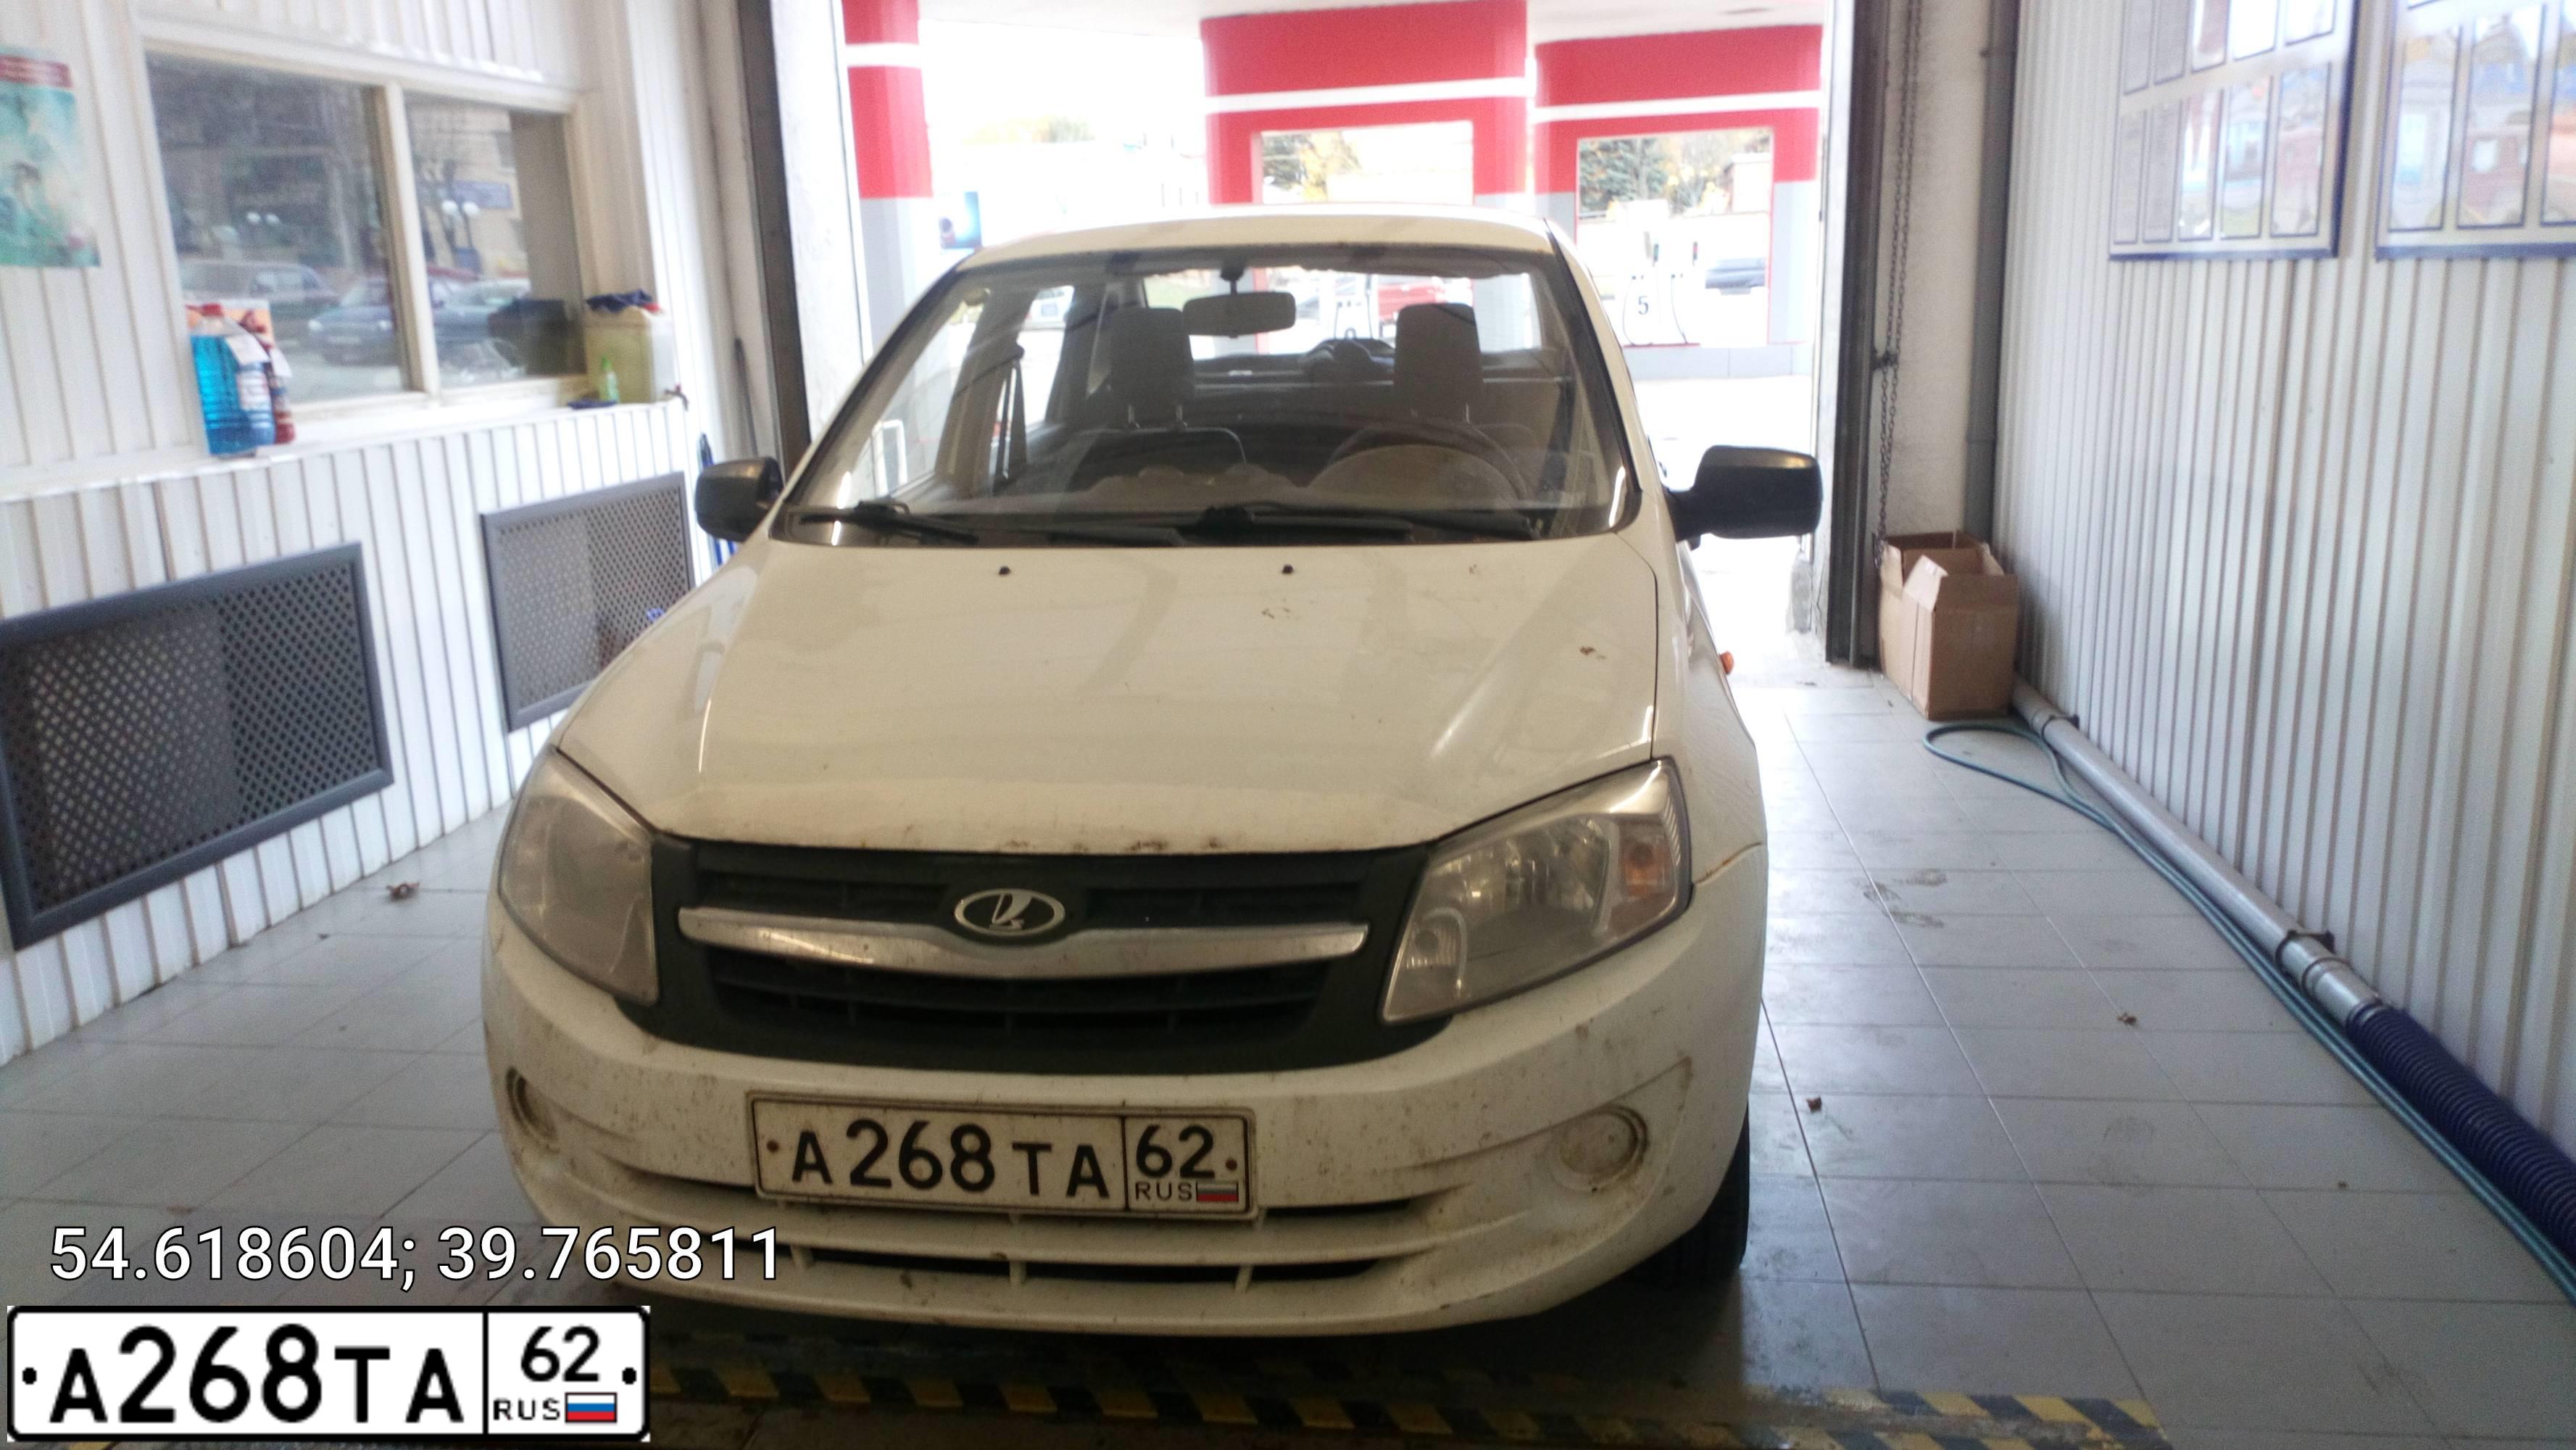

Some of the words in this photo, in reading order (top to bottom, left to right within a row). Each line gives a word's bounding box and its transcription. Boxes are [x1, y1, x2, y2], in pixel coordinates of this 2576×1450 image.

[1638, 296, 1649, 315] 5
[1136, 1124, 1216, 1179] 62
[1135, 1182, 1192, 1202] RUS
